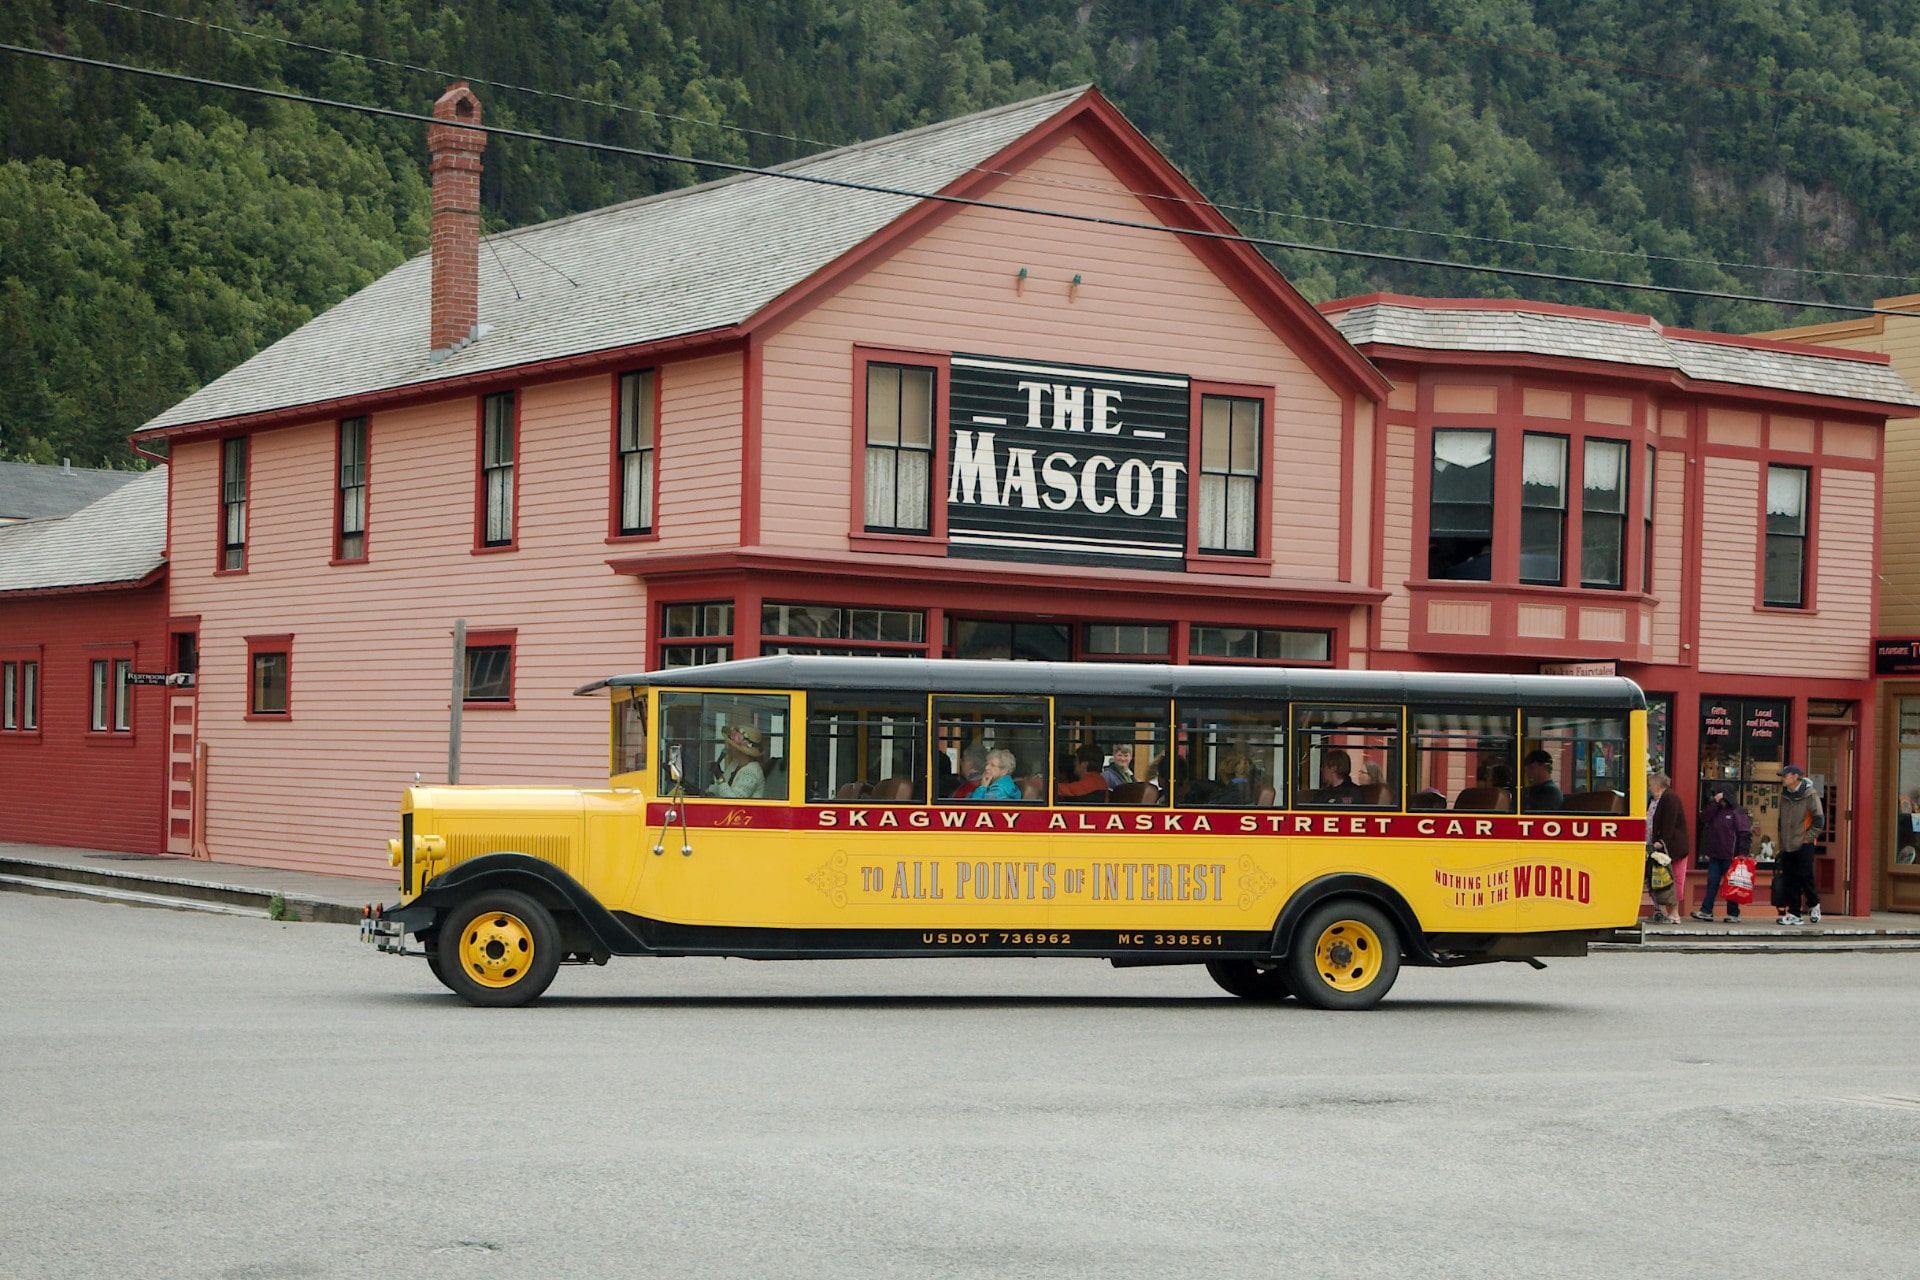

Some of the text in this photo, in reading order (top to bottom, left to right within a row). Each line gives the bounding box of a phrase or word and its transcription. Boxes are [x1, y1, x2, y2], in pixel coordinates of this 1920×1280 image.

[1018, 380, 1123, 435] THE
[947, 429, 1187, 519] MASCOT
[1746, 719, 1759, 727] and
[1755, 709, 1772, 717] Local
[1706, 727, 1729, 736] Alaska
[744, 815, 753, 826] 7
[818, 810, 1619, 838] SKAGWAY ALASKA STREET CAR TOUR
[861, 861, 1225, 902] TO ALL POINTS OF INTEREST
[1435, 869, 1509, 891] NOTHING LIKE
[1455, 864, 1590, 907] IT IN THE WORLD
[922, 933, 1223, 946] USDOT 736962 MC 338561
